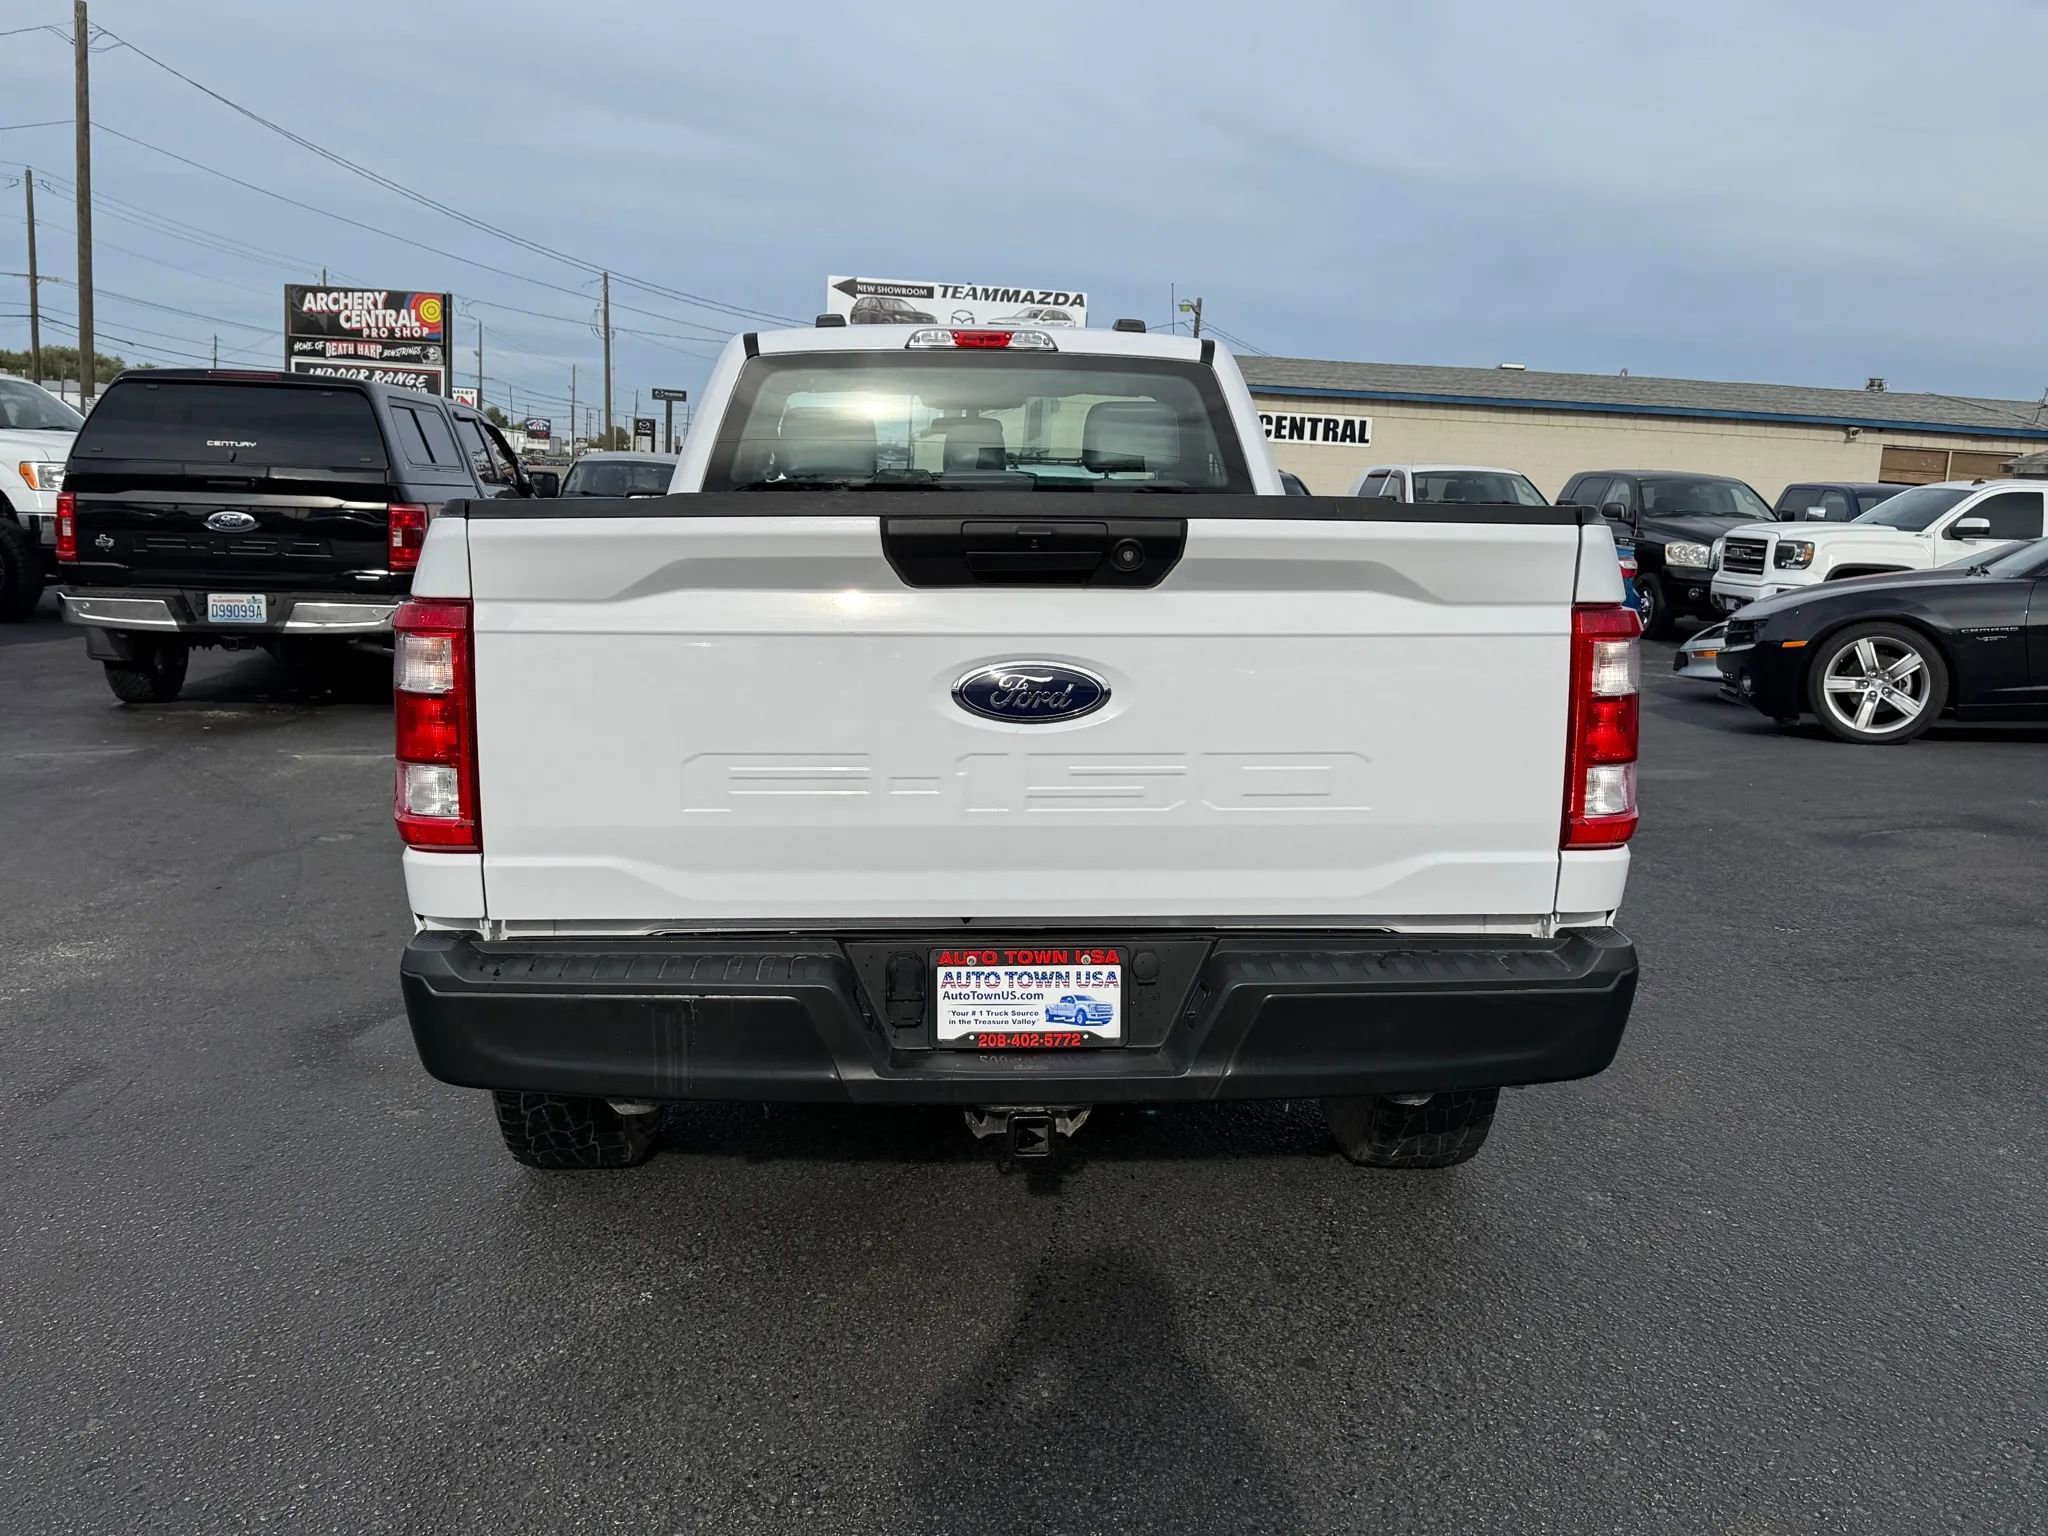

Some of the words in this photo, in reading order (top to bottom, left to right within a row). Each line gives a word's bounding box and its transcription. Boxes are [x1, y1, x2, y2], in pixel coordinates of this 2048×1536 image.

[857, 284, 876, 294] NEW
[877, 285, 928, 296] SHOWROOM
[302, 291, 388, 311] ARCHERY
[339, 309, 420, 329] CENTRAL
[362, 327, 388, 338] PRO
[395, 327, 429, 338] SHOP
[293, 342, 314, 352] HOME
[315, 341, 326, 351] OF
[325, 342, 355, 357] DEATH
[357, 343, 383, 359] HARP
[382, 346, 422, 358] BOWSTRINGS
[371, 370, 429, 388] RANGE
[1259, 414, 1370, 444] CENTRAL
[211, 604, 263, 618] D99099A
[990, 673, 1075, 710] Ford
[939, 950, 998, 965] AUTO
[1004, 950, 1067, 964] TOWN
[1075, 949, 1120, 965] USA
[941, 971, 1001, 989] AUTO
[1004, 971, 1070, 989] TOWN
[1076, 971, 1120, 989] USA
[942, 990, 1044, 1001] AutoTownUS.com
[973, 1018, 1010, 1026] Treasure
